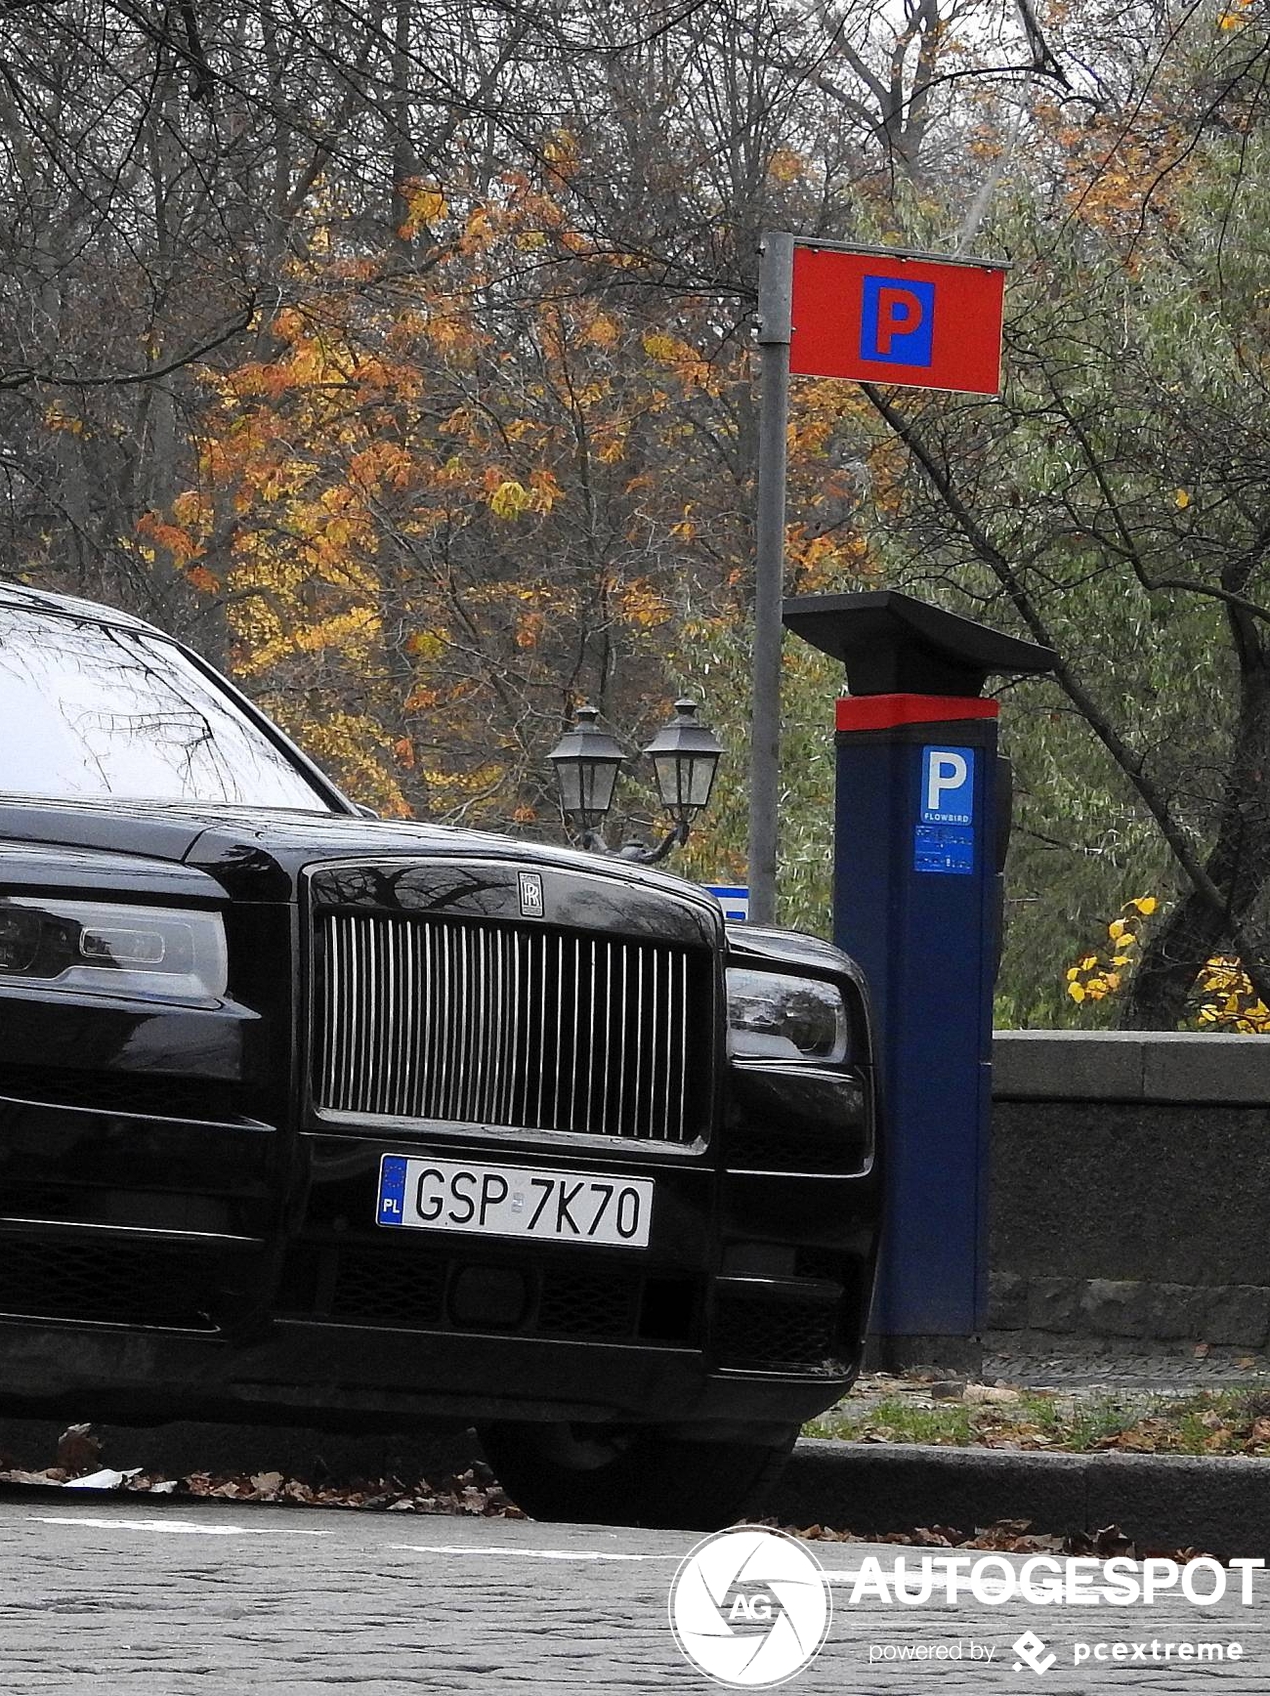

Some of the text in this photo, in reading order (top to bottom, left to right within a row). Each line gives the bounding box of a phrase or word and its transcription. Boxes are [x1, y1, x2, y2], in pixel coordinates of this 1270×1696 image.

[876, 286, 922, 355] P
[927, 751, 967, 810] P
[924, 812, 969, 823] FLOWBIRD
[383, 1198, 400, 1214] PL
[416, 1168, 640, 1238] GSP 7K70
